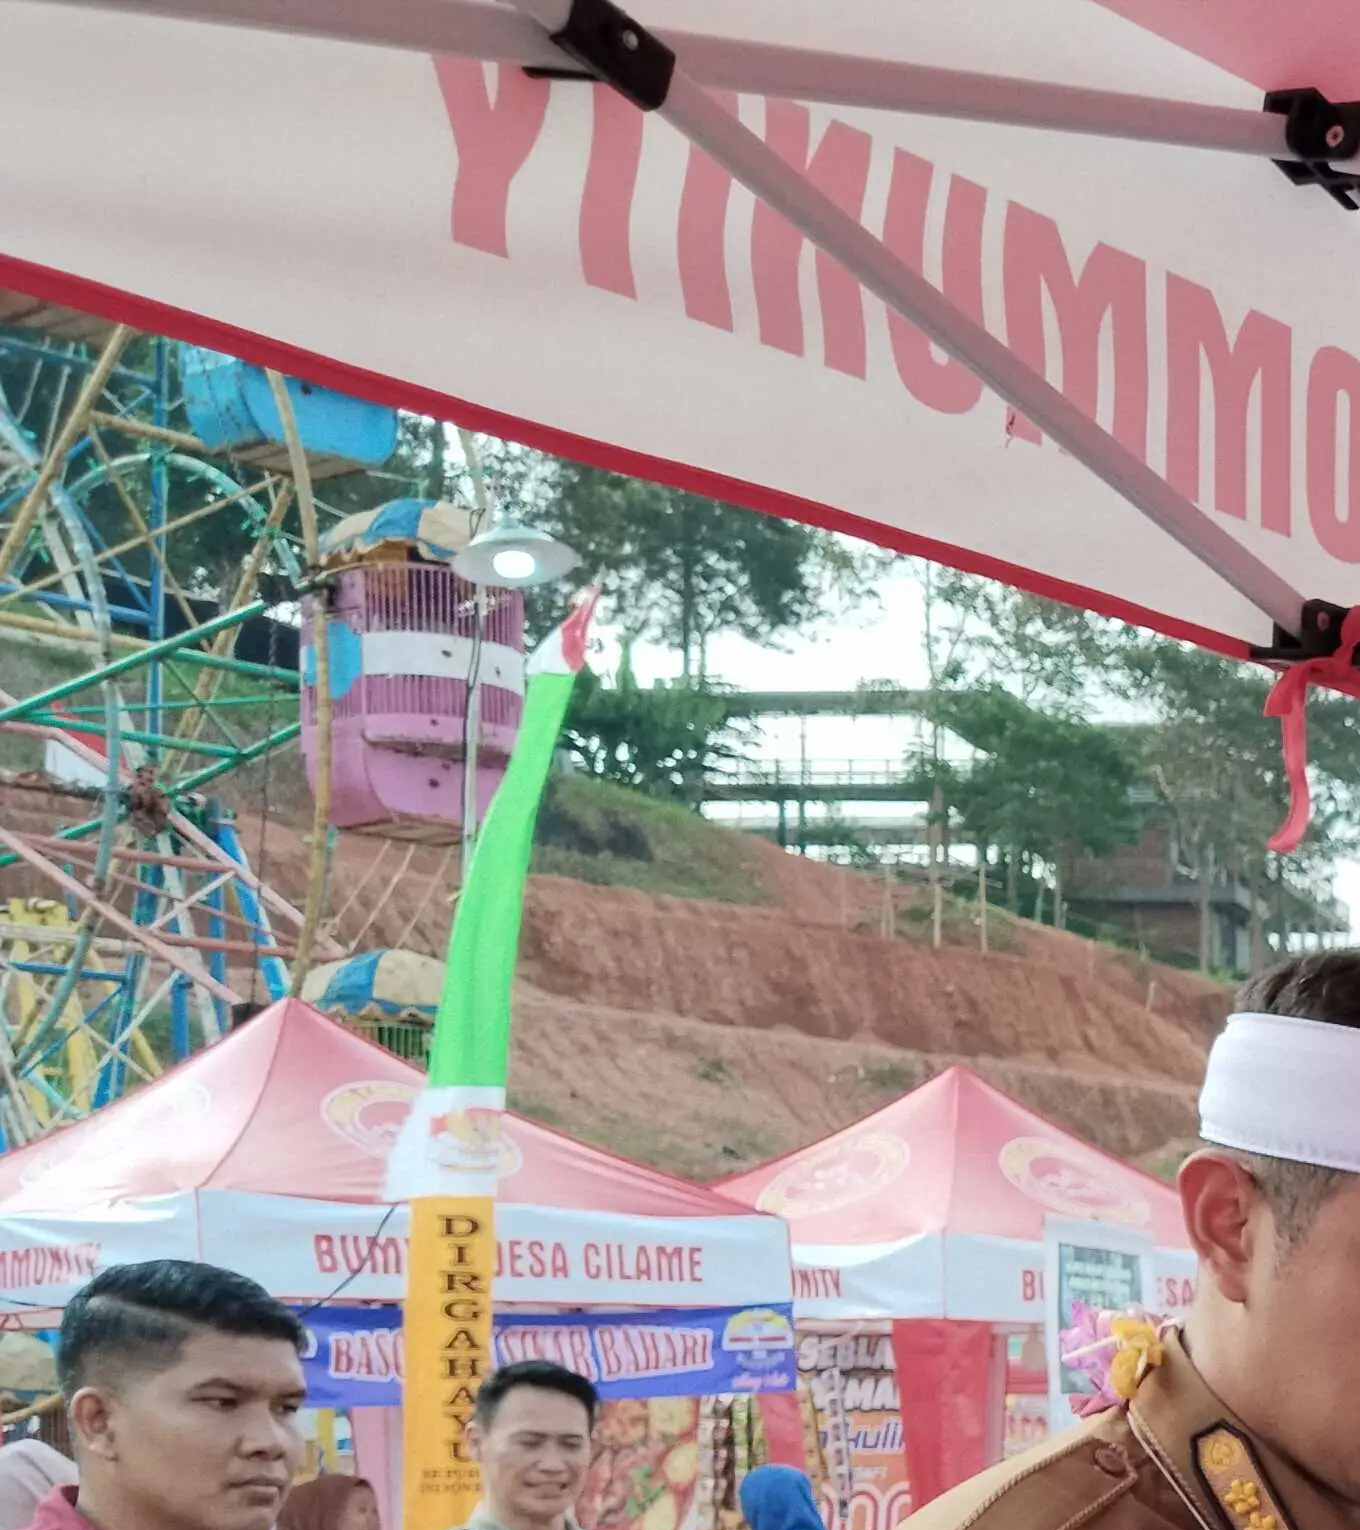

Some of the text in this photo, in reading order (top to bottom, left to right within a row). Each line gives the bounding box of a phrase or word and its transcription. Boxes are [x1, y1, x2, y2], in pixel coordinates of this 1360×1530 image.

[313, 1233, 410, 1275] BUM
[582, 1241, 704, 1283] CILAME
[600, 1325, 709, 1377] BAHARI
[799, 1334, 897, 1372] SEBLA
